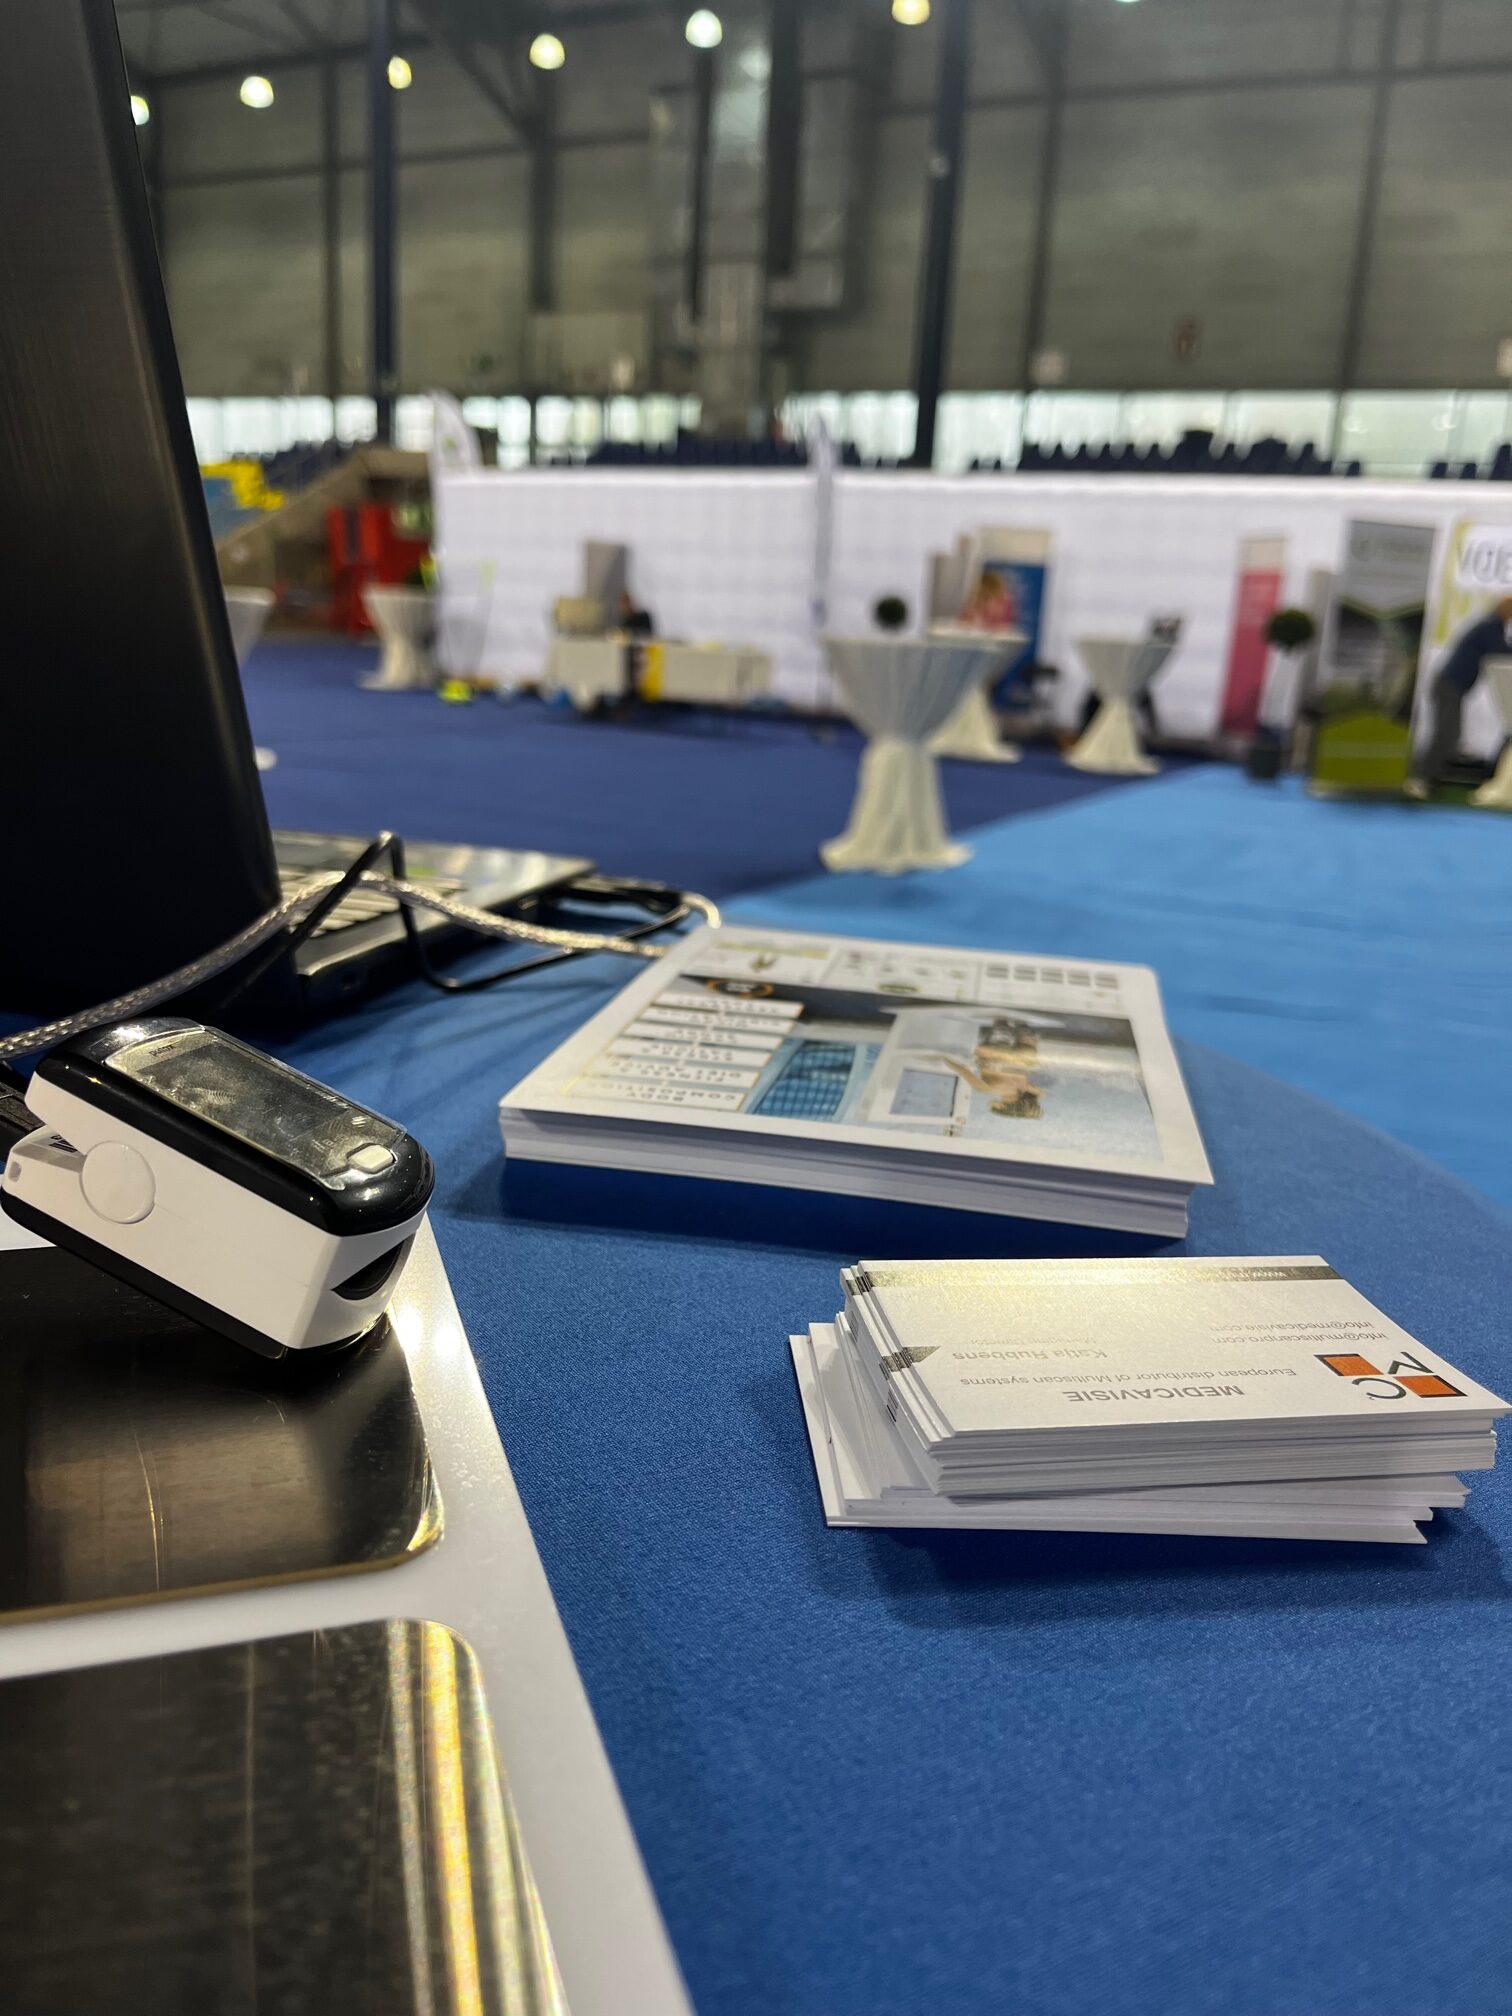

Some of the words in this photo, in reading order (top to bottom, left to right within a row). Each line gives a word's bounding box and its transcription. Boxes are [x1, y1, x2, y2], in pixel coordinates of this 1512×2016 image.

[1208, 1320, 1374, 1332] info@medicavisie.com
[1212, 1332, 1388, 1345] info@multiscanpro.com
[951, 1349, 1047, 1362] Rubbens
[1117, 1373, 1131, 1384] of
[1136, 1370, 1215, 1382] distributor
[1218, 1367, 1297, 1380] European
[960, 1375, 1029, 1387] systems
[1034, 1374, 1112, 1386] Multiscan
[1062, 1385, 1244, 1403] MEDICAVISIE
